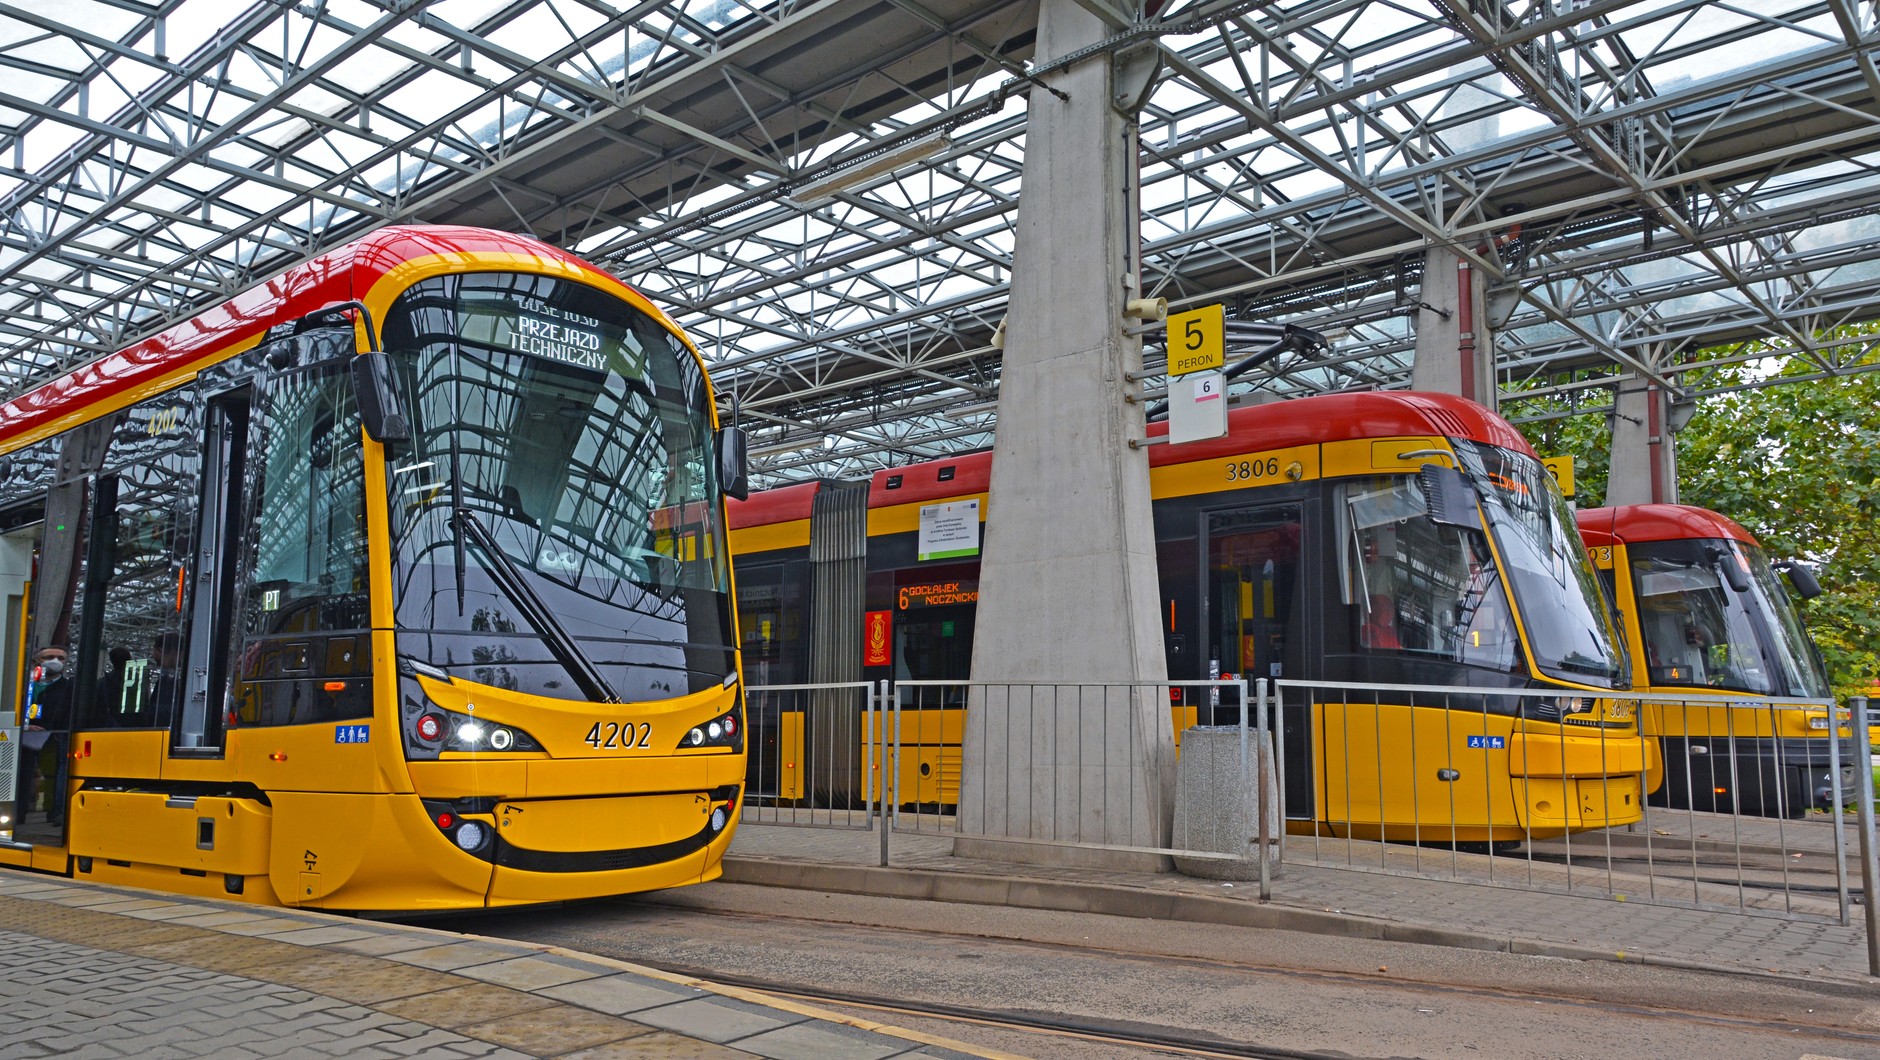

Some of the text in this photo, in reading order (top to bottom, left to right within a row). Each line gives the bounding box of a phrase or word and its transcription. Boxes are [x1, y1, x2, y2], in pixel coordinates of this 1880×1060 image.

[518, 315, 600, 351] PRZEJAZD
[1185, 318, 1204, 351] 5
[508, 331, 607, 370] TECHNICZNY
[1177, 353, 1214, 370] PERON
[1202, 380, 1211, 393] 6
[147, 405, 178, 438] 4202
[1225, 457, 1279, 482] 3806
[1588, 547, 1611, 562] 03
[265, 590, 280, 610] PT
[899, 582, 959, 611] 6 GOCŁAWEK
[1471, 631, 1479, 647] 1
[120, 658, 148, 714] PT
[1671, 667, 1679, 680] 4
[584, 721, 653, 750] 4202
